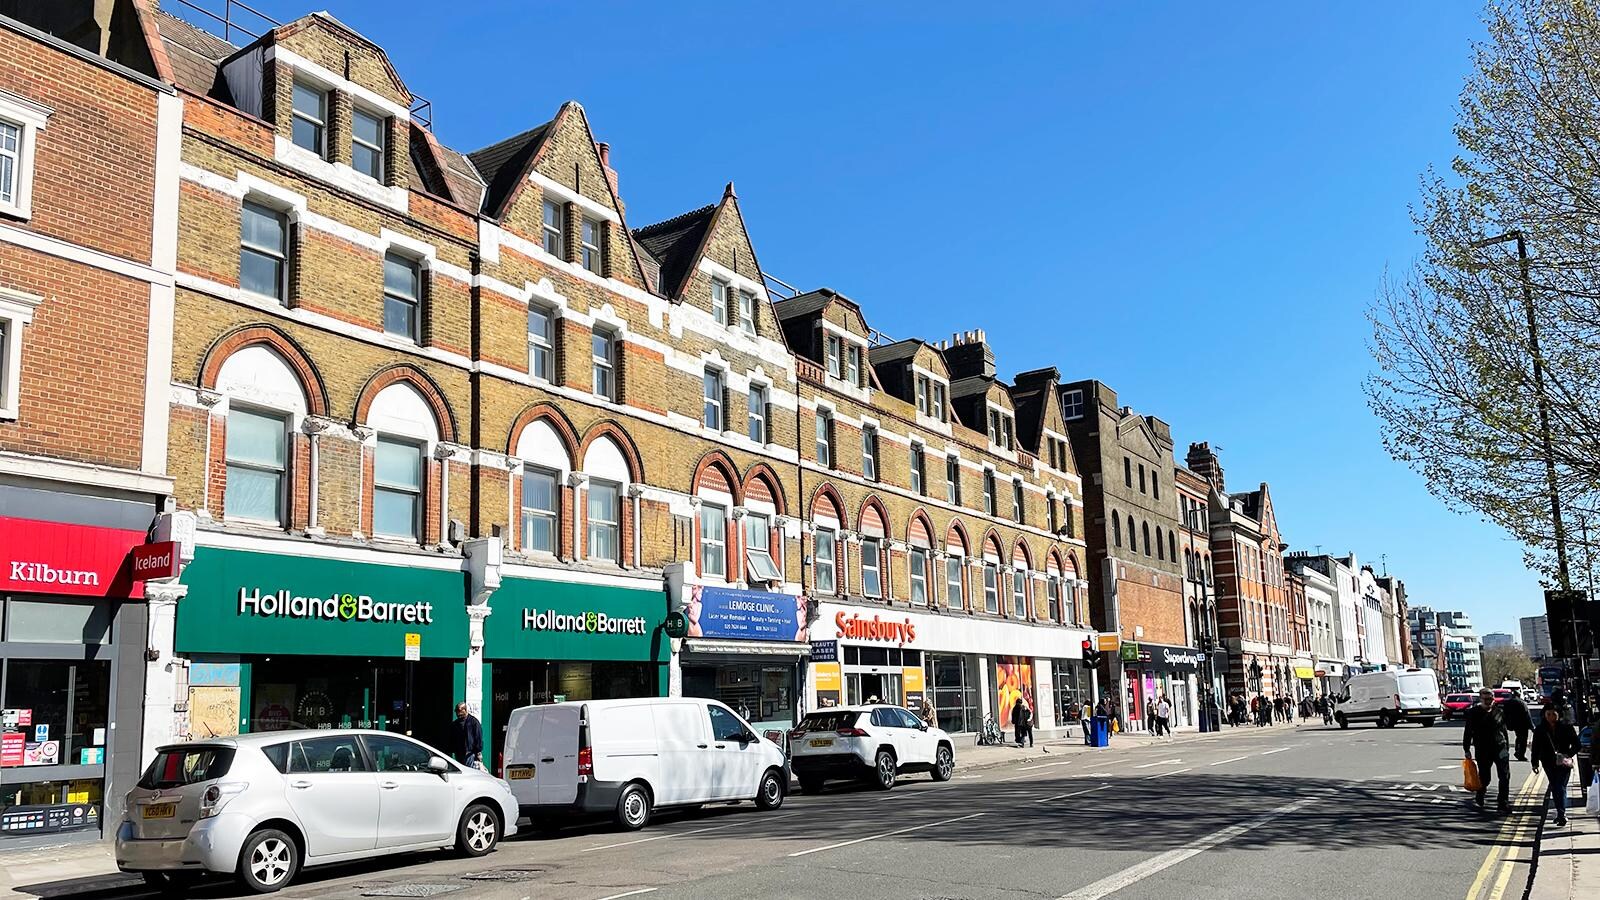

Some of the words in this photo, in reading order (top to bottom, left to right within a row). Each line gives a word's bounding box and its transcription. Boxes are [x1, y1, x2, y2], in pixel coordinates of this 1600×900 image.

[10, 561, 99, 586] Kilburn
[135, 552, 170, 570] Iceland
[240, 587, 433, 622] Holland&Barrett
[728, 601, 755, 612] LEMOGE
[756, 604, 775, 613] CLINIC
[524, 608, 646, 634] Holland&Barrett
[834, 610, 916, 647] Sainsbury's
[1164, 648, 1198, 668] Superdrug
